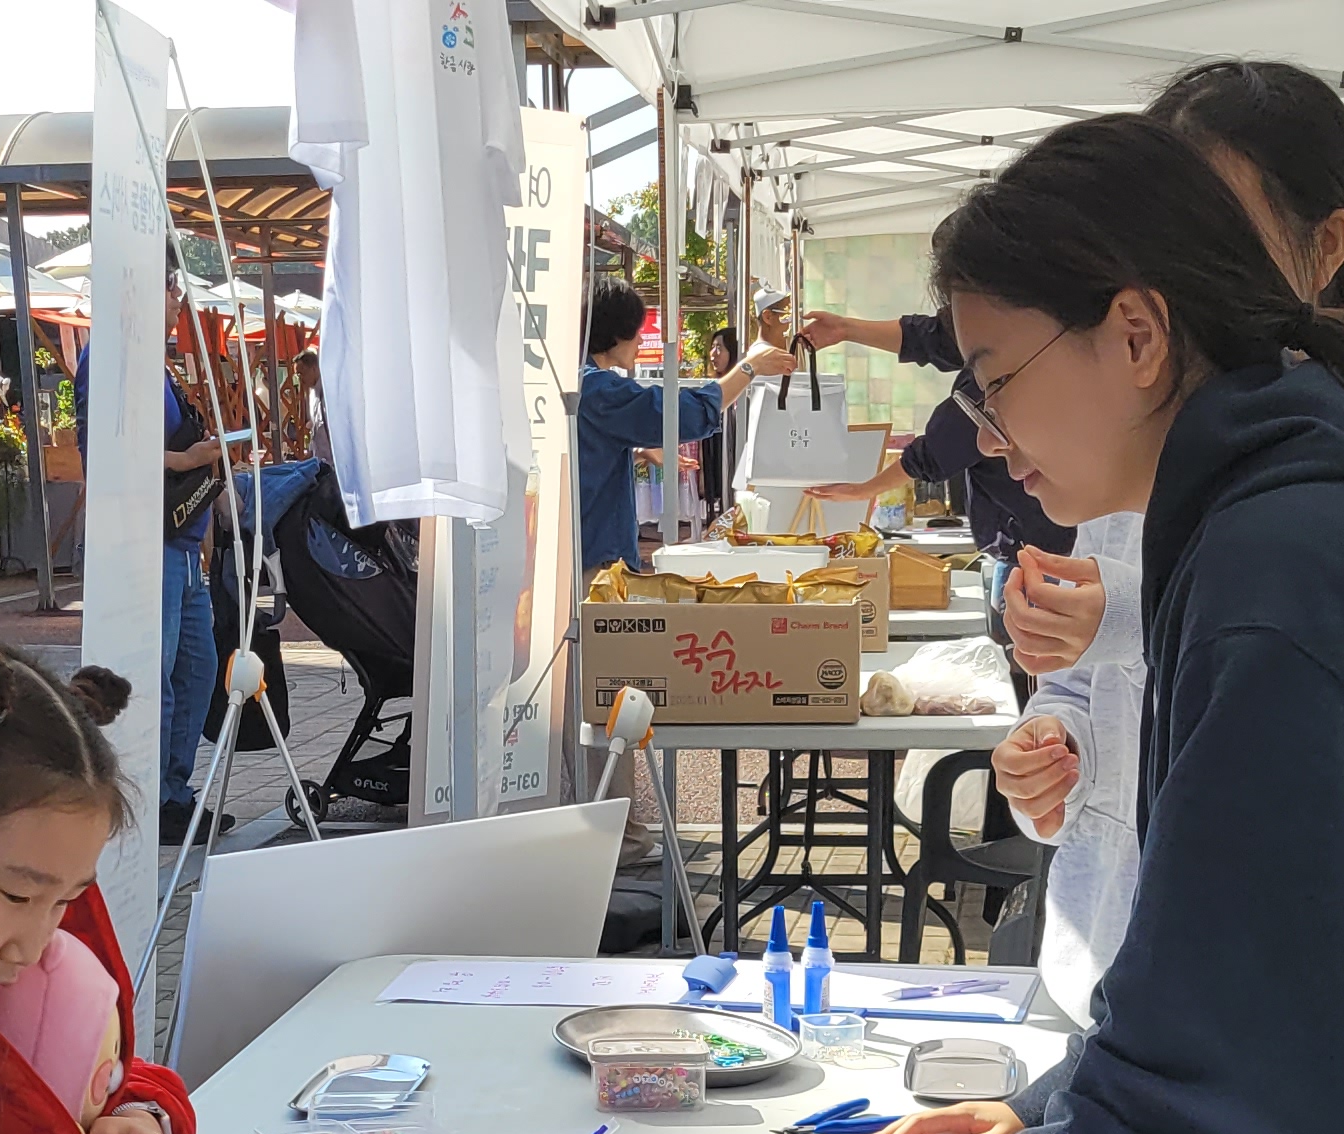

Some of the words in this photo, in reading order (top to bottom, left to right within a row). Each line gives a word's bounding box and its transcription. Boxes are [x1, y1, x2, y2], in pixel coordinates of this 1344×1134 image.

[823, 621, 849, 630] Brand
[673, 630, 736, 673] 국수
[711, 670, 784, 696] 과자
